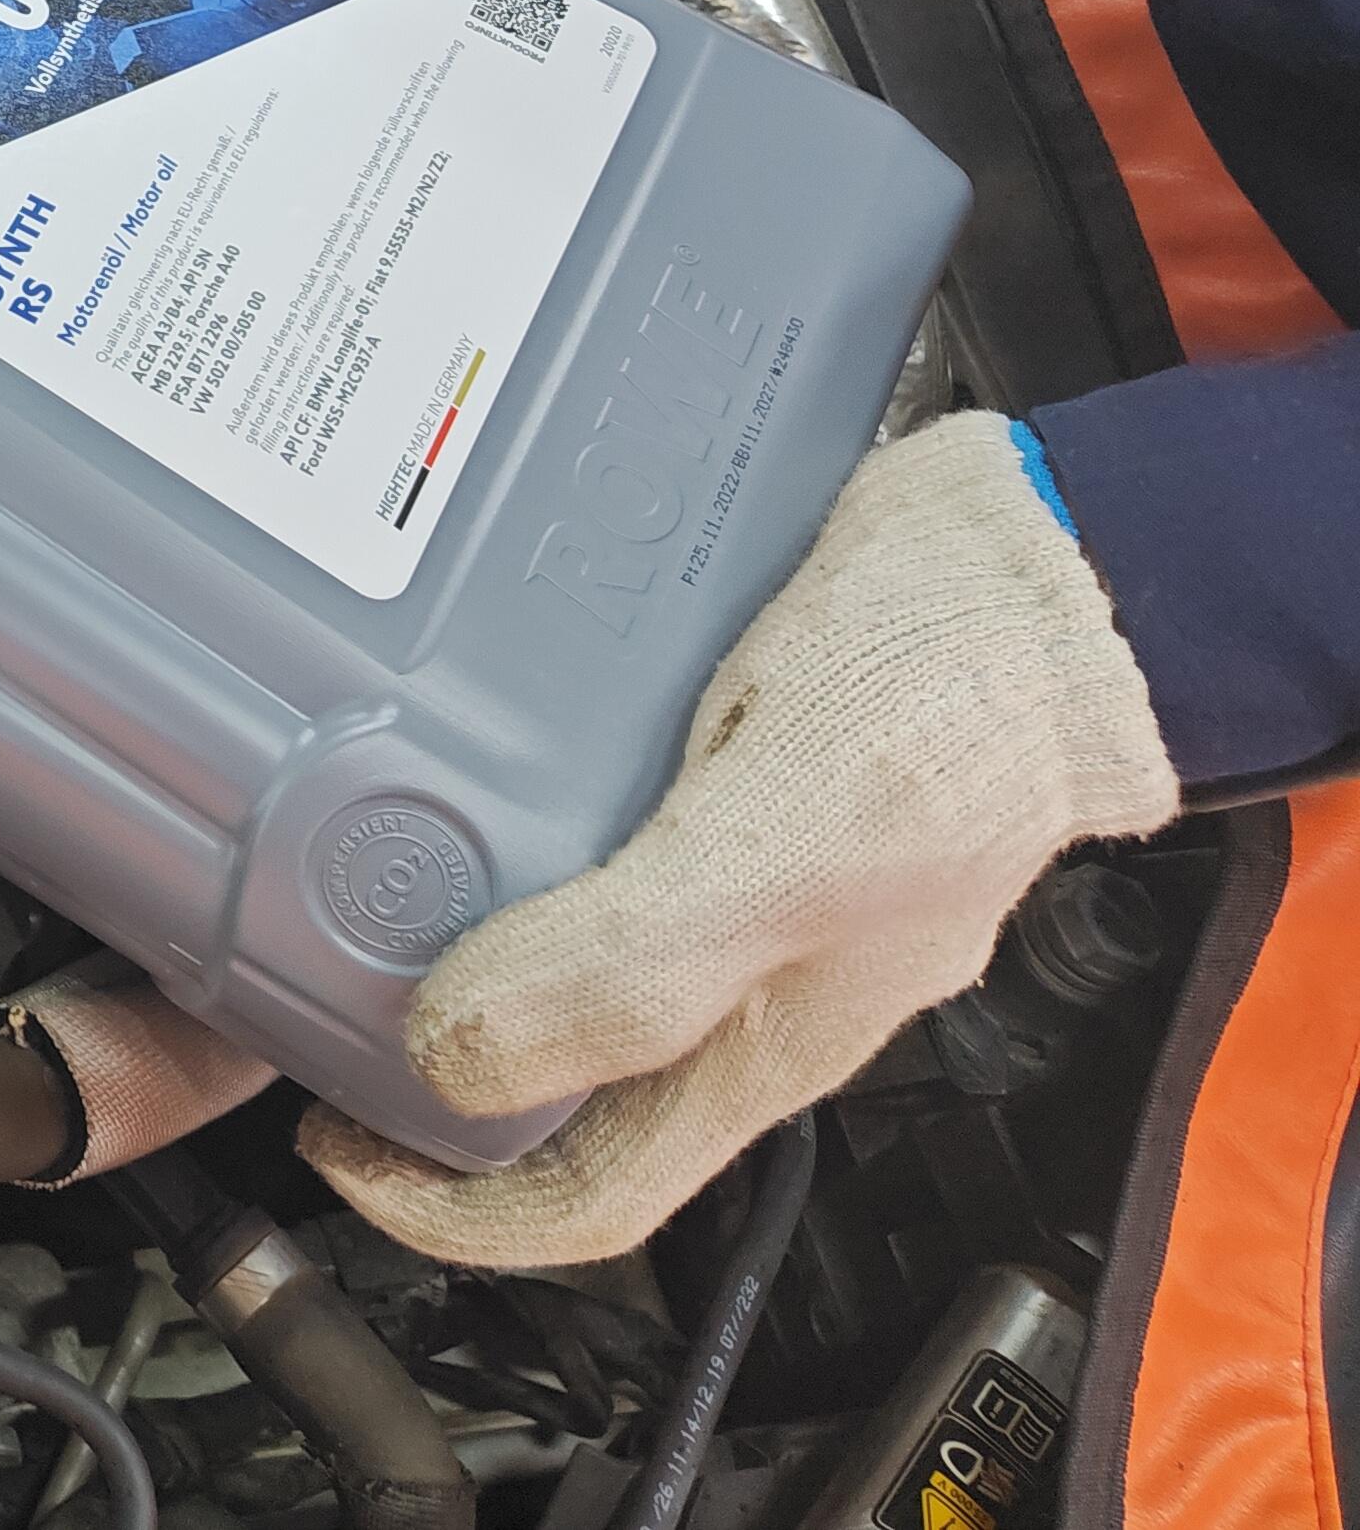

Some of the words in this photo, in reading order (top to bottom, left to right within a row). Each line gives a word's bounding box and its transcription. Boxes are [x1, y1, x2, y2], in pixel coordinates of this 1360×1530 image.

[465, 14, 545, 63] PRODUKTINFO
[599, 26, 622, 58] 20020
[431, 39, 465, 84] following
[410, 101, 430, 128] when
[424, 84, 440, 101] the
[226, 161, 239, 173] to
[231, 144, 247, 162] EU
[373, 126, 416, 201] recommended
[197, 173, 232, 225] equivalent
[364, 200, 378, 211] is
[56, 246, 125, 346] Motorenöl
[120, 185, 163, 237] Motor
[153, 154, 178, 183] oil
[189, 226, 202, 237] is
[346, 209, 373, 253] product
[96, 309, 133, 363] Qualitativ
[128, 244, 173, 310] gleichwertig
[165, 219, 185, 244] nach
[177, 172, 212, 218] EU-Recht
[168, 235, 197, 280] product
[334, 250, 351, 271] this
[9, 278, 52, 324] RS
[150, 295, 161, 310] of
[155, 277, 173, 298] this
[225, 374, 265, 435] Außerdem
[260, 346, 279, 372] wird
[272, 311, 298, 347] dieses
[289, 268, 321, 311] Produkt
[315, 213, 352, 268] empfohlen,
[346, 181, 367, 209] wenn
[358, 137, 390, 181] folgende
[300, 271, 343, 336] Additionally
[365, 269, 389, 295] Fiat
[128, 311, 156, 350] quality
[131, 344, 162, 384] ACEA
[153, 295, 190, 343] A3/B4;
[180, 269, 202, 296] API
[193, 248, 213, 270] SN
[149, 369, 172, 394] MB
[163, 328, 198, 370] 229.5;
[186, 276, 225, 327] Porsche
[216, 245, 240, 275] A40
[325, 295, 378, 373] Longlife-01;
[112, 350, 132, 371] The
[169, 376, 196, 405] PSA
[186, 348, 210, 374] B71
[201, 313, 228, 348] 2296
[189, 386, 214, 413] VW
[205, 360, 230, 388] 502
[221, 310, 255, 359] 00/505
[247, 291, 266, 310] 00
[260, 421, 288, 454] filling
[277, 353, 321, 421] instructions
[315, 334, 331, 353] are
[325, 285, 356, 334] required:
[274, 343, 304, 387] werden:
[299, 439, 327, 476] Ford
[316, 336, 382, 439] WSS-M2C937-A
[305, 371, 335, 412] BMW
[246, 388, 280, 446] gefordert
[294, 413, 318, 435] CF;
[376, 454, 416, 521] HIGHTEC
[406, 413, 436, 458] MADE
[426, 397, 444, 417] IN
[435, 332, 474, 399] GERMANY
[280, 435, 303, 465] API
[524, 263, 765, 639] ROWE
